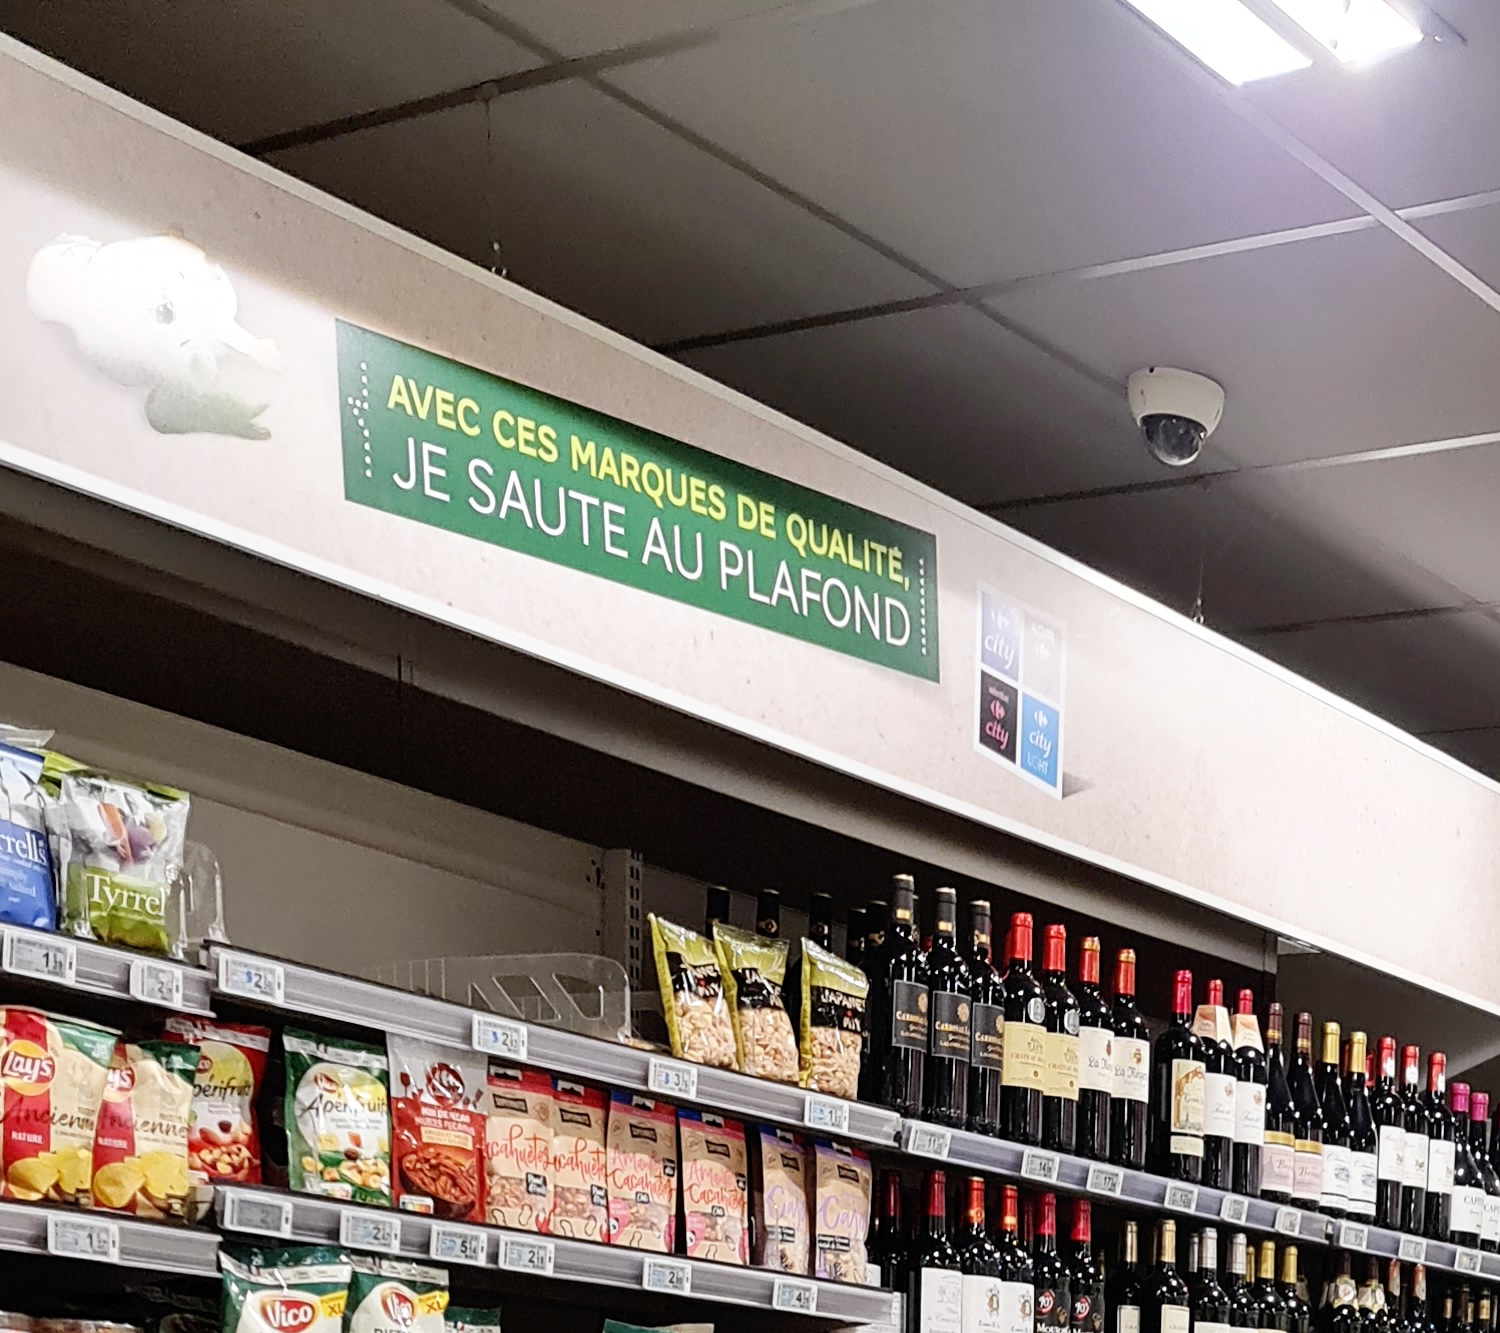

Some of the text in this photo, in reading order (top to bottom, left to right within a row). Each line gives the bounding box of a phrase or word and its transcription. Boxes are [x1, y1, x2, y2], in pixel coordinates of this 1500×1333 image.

[387, 374, 910, 592] AVEC CES MARQUES DE QUALITÉ,
[392, 437, 911, 647] JE SAUTE AU PLAFOND
[984, 634, 1015, 670] city
[985, 720, 1009, 750] city
[1029, 729, 1052, 759] city
[3, 1052, 53, 1082] Lay's
[266, 1301, 313, 1329] Vico
